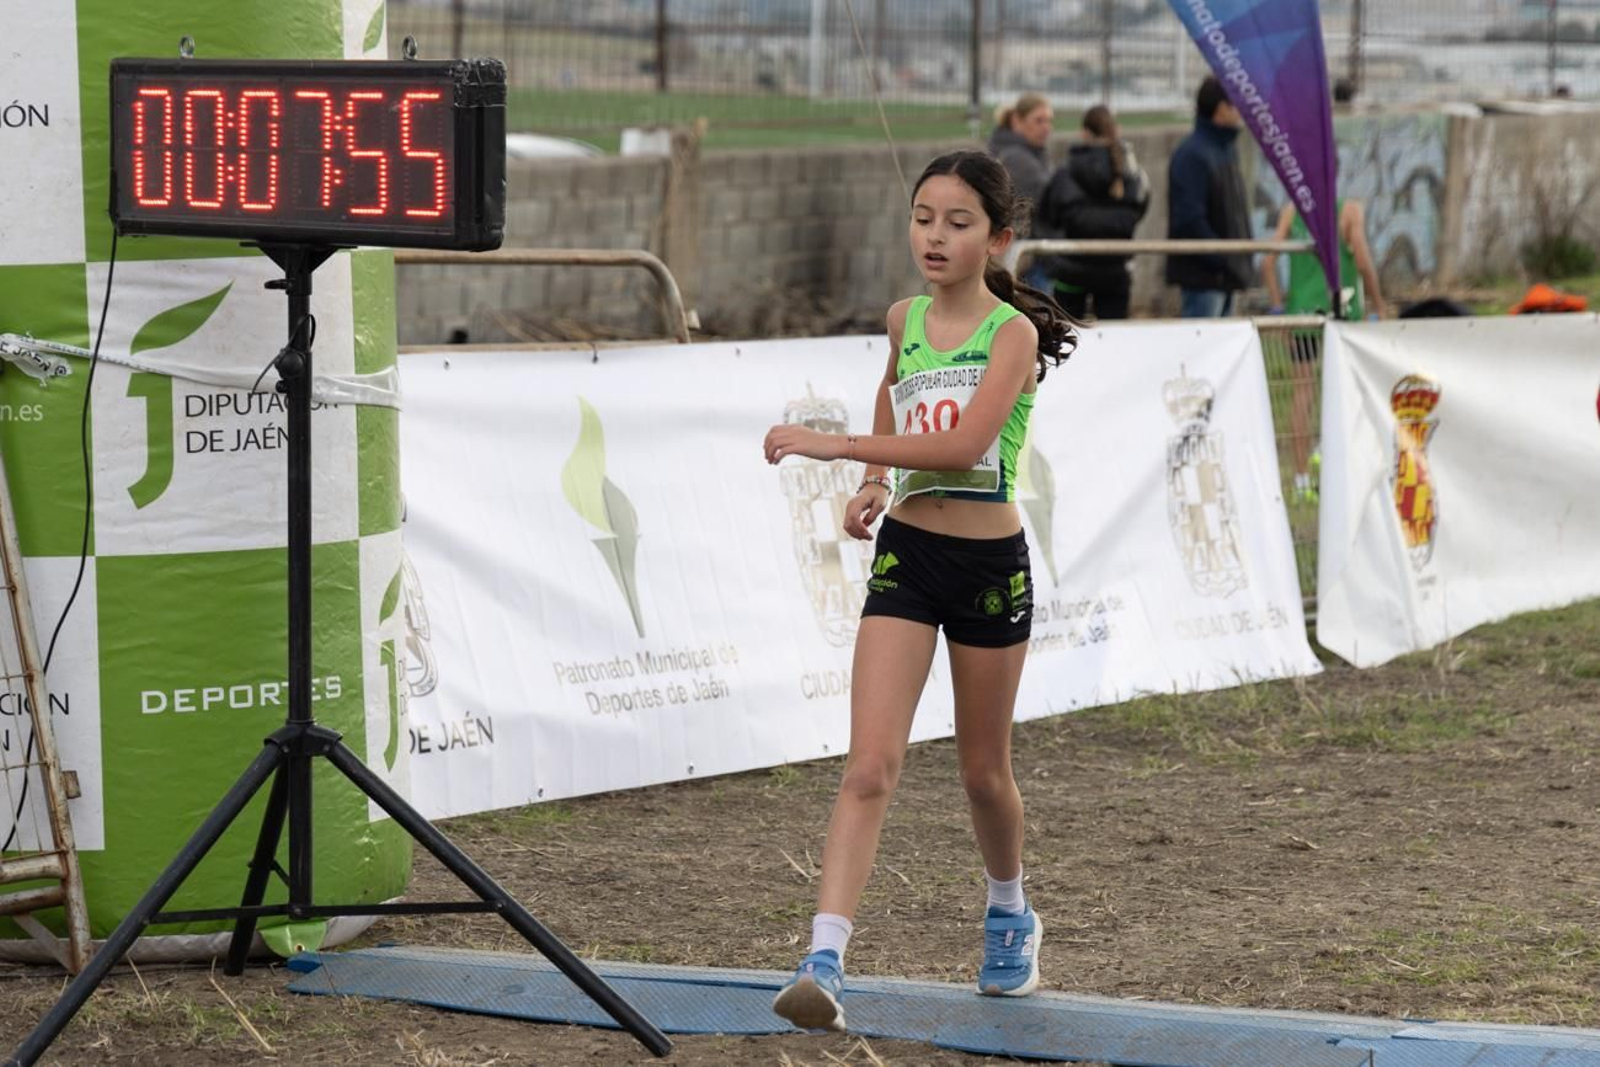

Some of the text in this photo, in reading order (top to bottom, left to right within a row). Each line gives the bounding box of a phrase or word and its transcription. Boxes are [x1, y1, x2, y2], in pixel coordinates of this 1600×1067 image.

[0, 99, 49, 128] ÓN
[133, 88, 447, 216] 00:07:55
[942, 368, 967, 389] CIUDAD
[968, 368, 978, 387] DE
[184, 391, 338, 418] DIPUTA
[185, 430, 225, 453] DE
[552, 640, 740, 687] Patronato Municipal de
[585, 672, 730, 719] Deportes de Jaén
[800, 668, 850, 699] CIUDA
[437, 711, 494, 751] JAÉN
